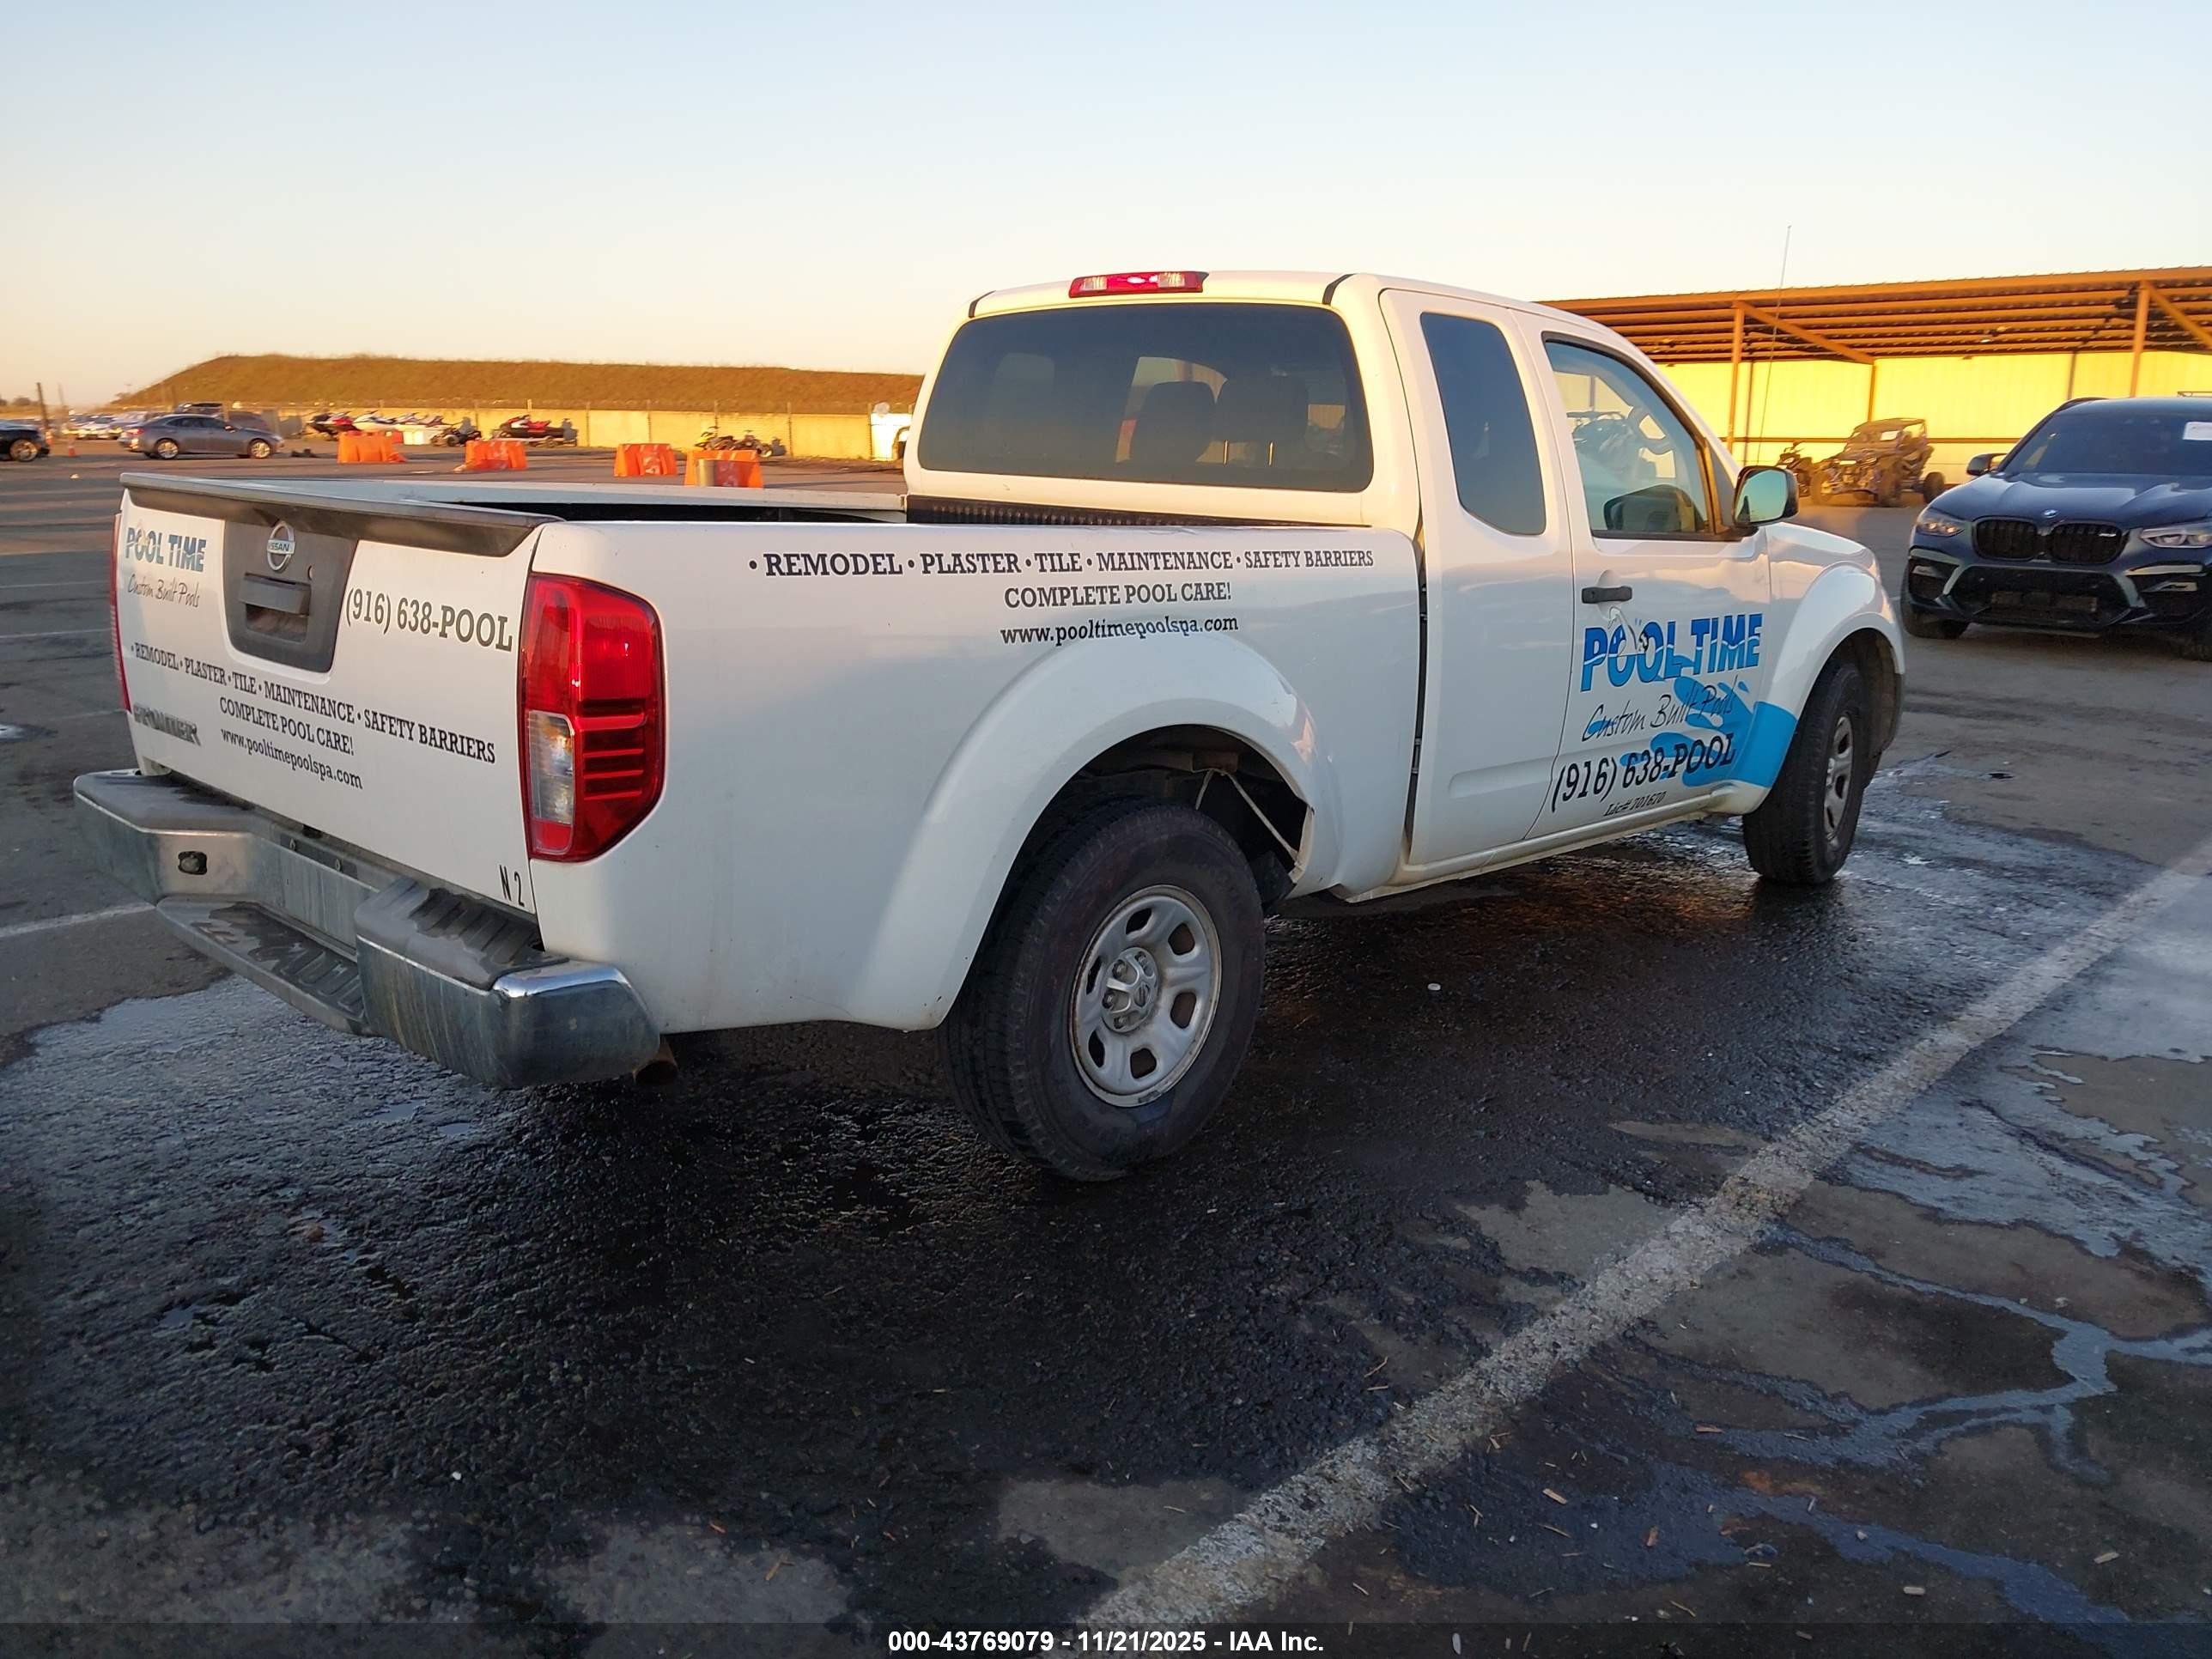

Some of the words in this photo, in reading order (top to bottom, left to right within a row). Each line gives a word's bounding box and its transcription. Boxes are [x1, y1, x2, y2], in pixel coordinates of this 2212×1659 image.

[125, 527, 164, 565] POOL
[168, 534, 207, 573] TIME
[270, 541, 290, 552] SSAN
[763, 553, 902, 576] REMODEL
[920, 552, 1022, 574] PLASTER
[1034, 552, 1083, 573] TILE
[1097, 550, 1234, 572] MAINTENANCE
[1245, 550, 1300, 568] SAFETY
[1304, 550, 1374, 568] BARRIERS
[128, 574, 154, 599] Custom
[155, 576, 179, 602] Built
[178, 581, 200, 608] Pools
[346, 587, 392, 635] (916)
[397, 597, 513, 653] 638-POOL
[1004, 585, 1121, 608] COMPLETE
[1124, 583, 1177, 605] POOL
[1181, 581, 1232, 602] CARE!
[1000, 616, 1239, 647] www.pooltimepoolspa.com
[1580, 620, 1680, 692] POOL
[1691, 613, 1763, 675] TIME
[135, 642, 179, 671] REMODEL
[185, 657, 227, 686] PLASTER
[232, 672, 257, 695] TILE
[264, 681, 356, 724] MAINTENANCE
[364, 708, 415, 741] SAFETY
[418, 723, 495, 764] BARRIERS
[220, 696, 279, 732] COMPLETE
[280, 716, 315, 744] POOL
[316, 727, 355, 756] CARE!
[1582, 700, 1646, 742] Custom
[1650, 681, 1697, 728] Built
[221, 728, 363, 789] www.pooltimepoolspa.com
[1552, 757, 1618, 812] (916)
[1621, 732, 1737, 788] 638-POOL
